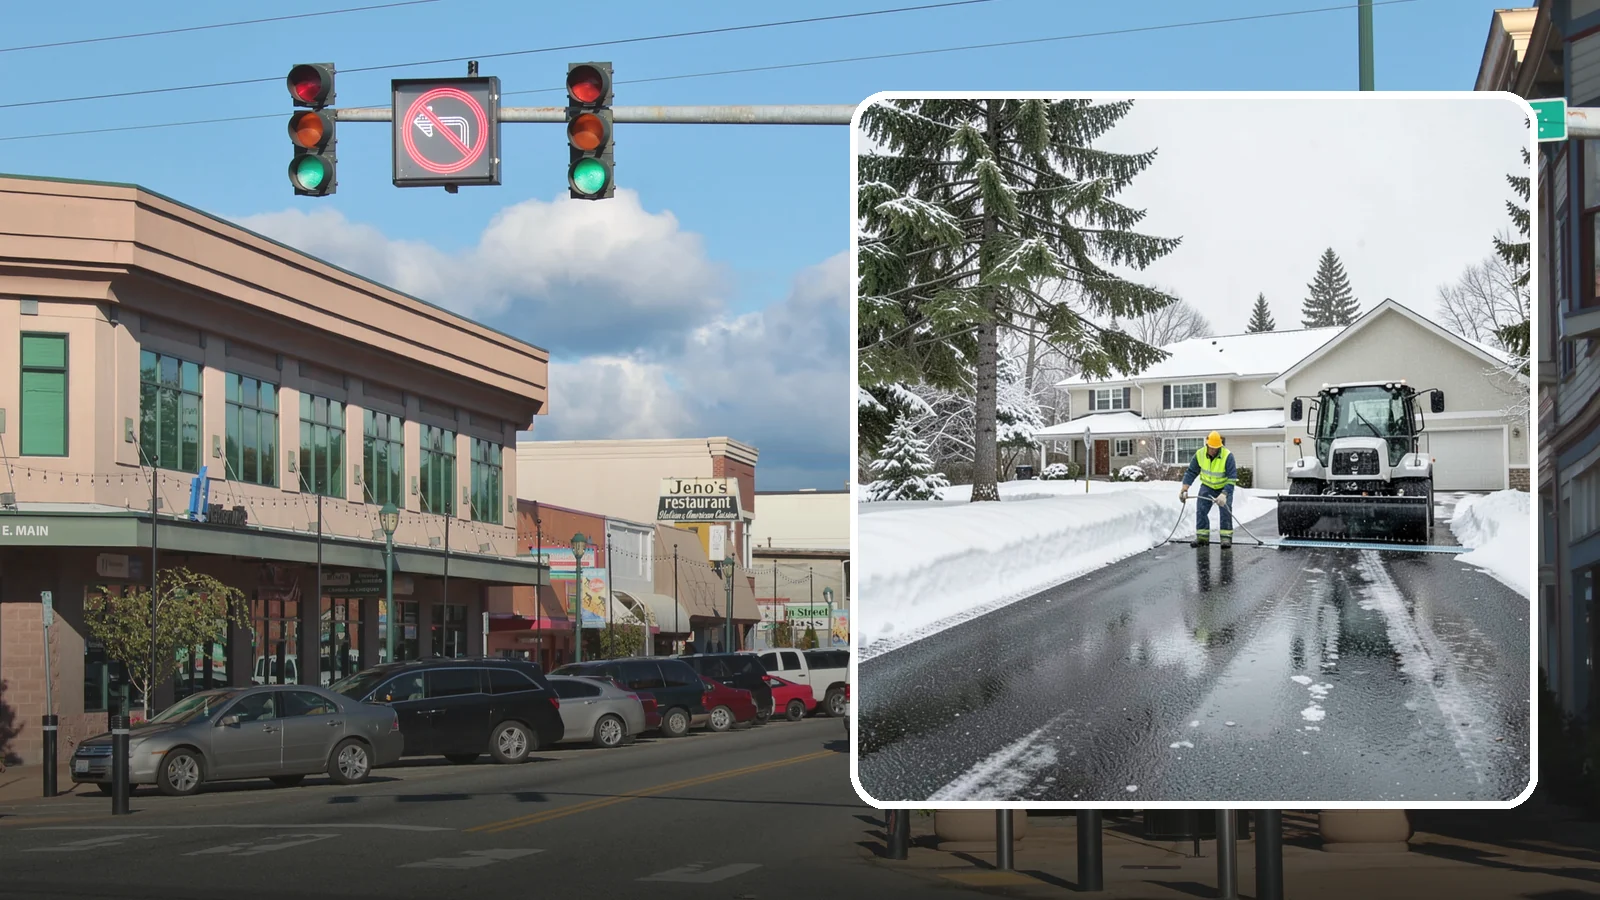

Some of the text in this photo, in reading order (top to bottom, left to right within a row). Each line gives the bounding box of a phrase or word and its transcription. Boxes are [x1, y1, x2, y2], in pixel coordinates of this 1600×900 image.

[670, 480, 727, 494] Jeno's
[665, 496, 731, 509] restaurant
[658, 510, 681, 519] Italian
[685, 509, 714, 519] American
[714, 509, 738, 519] Cuisine
[2, 525, 49, 536] E. MAIN
[797, 607, 828, 617] Street
